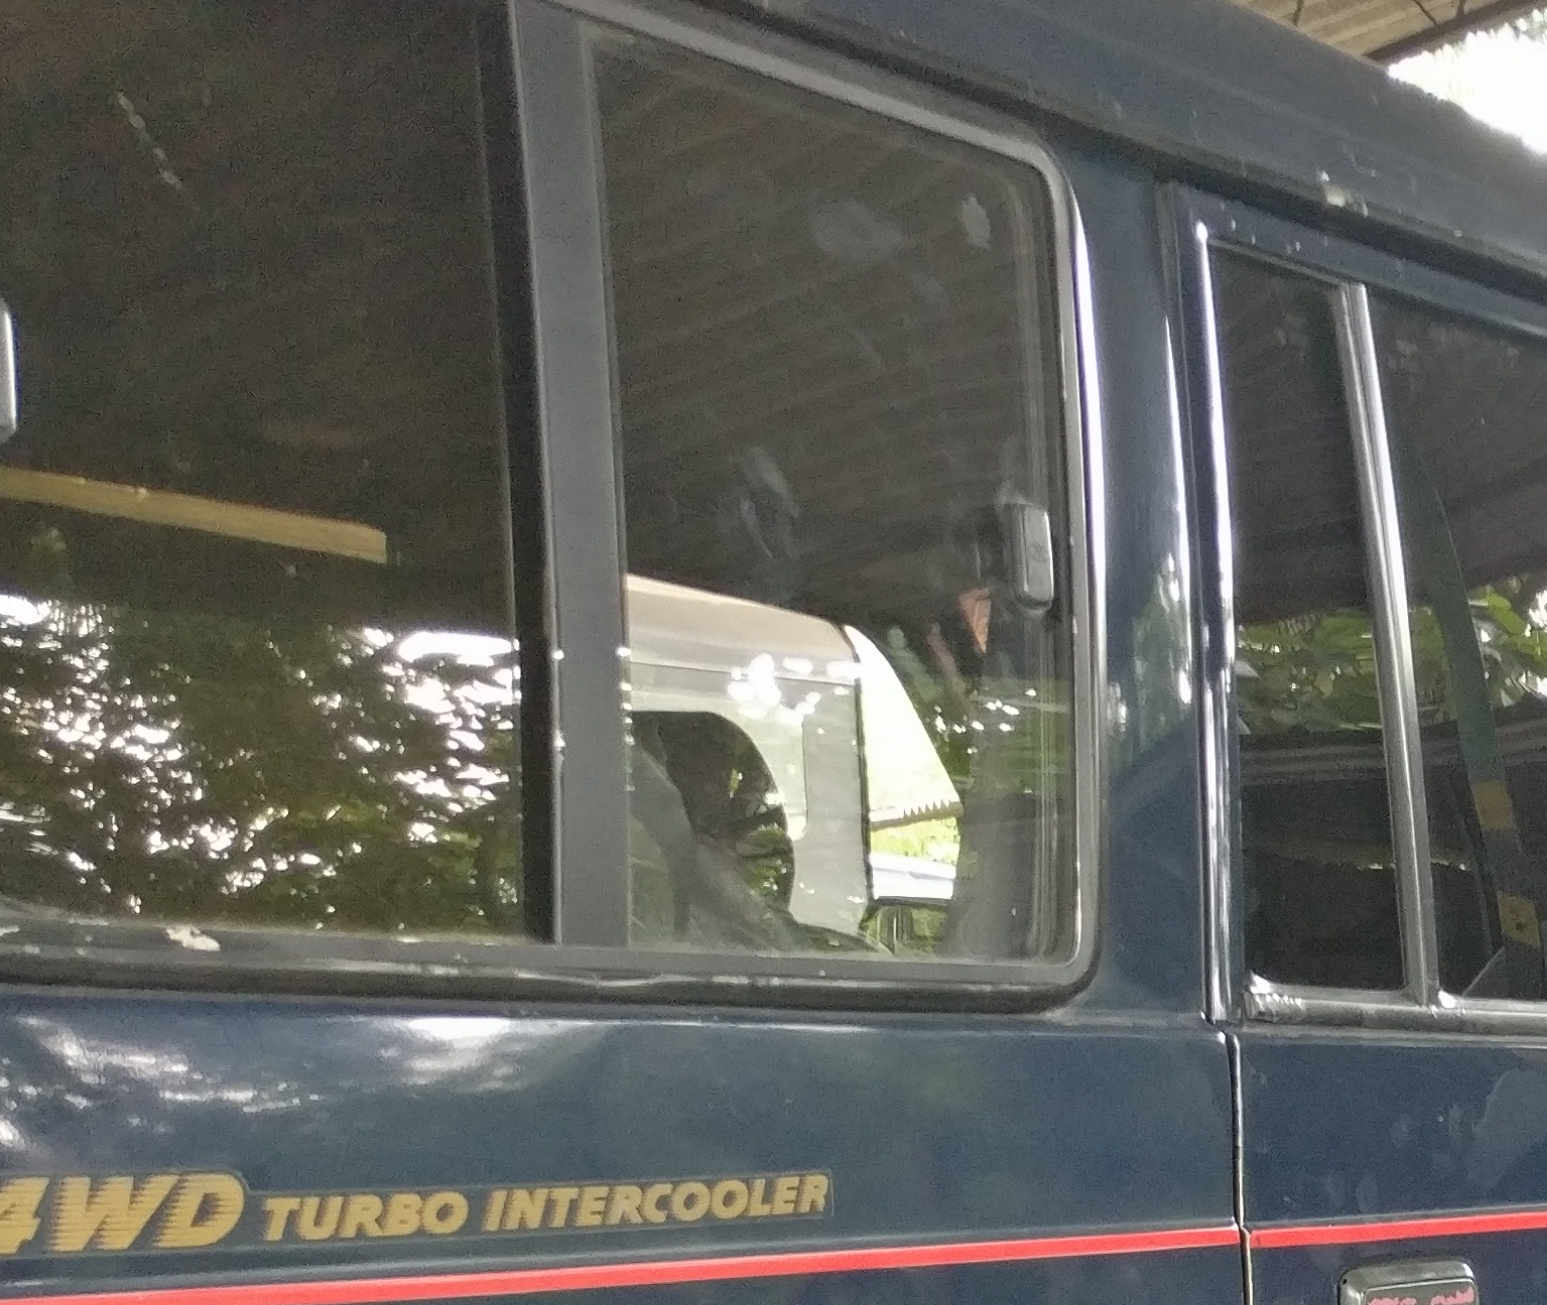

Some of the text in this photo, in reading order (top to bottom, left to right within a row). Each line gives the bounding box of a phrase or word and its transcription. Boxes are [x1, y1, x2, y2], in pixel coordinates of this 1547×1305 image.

[0, 1170, 832, 1255] 4WD TURBO INTERCOOLER
